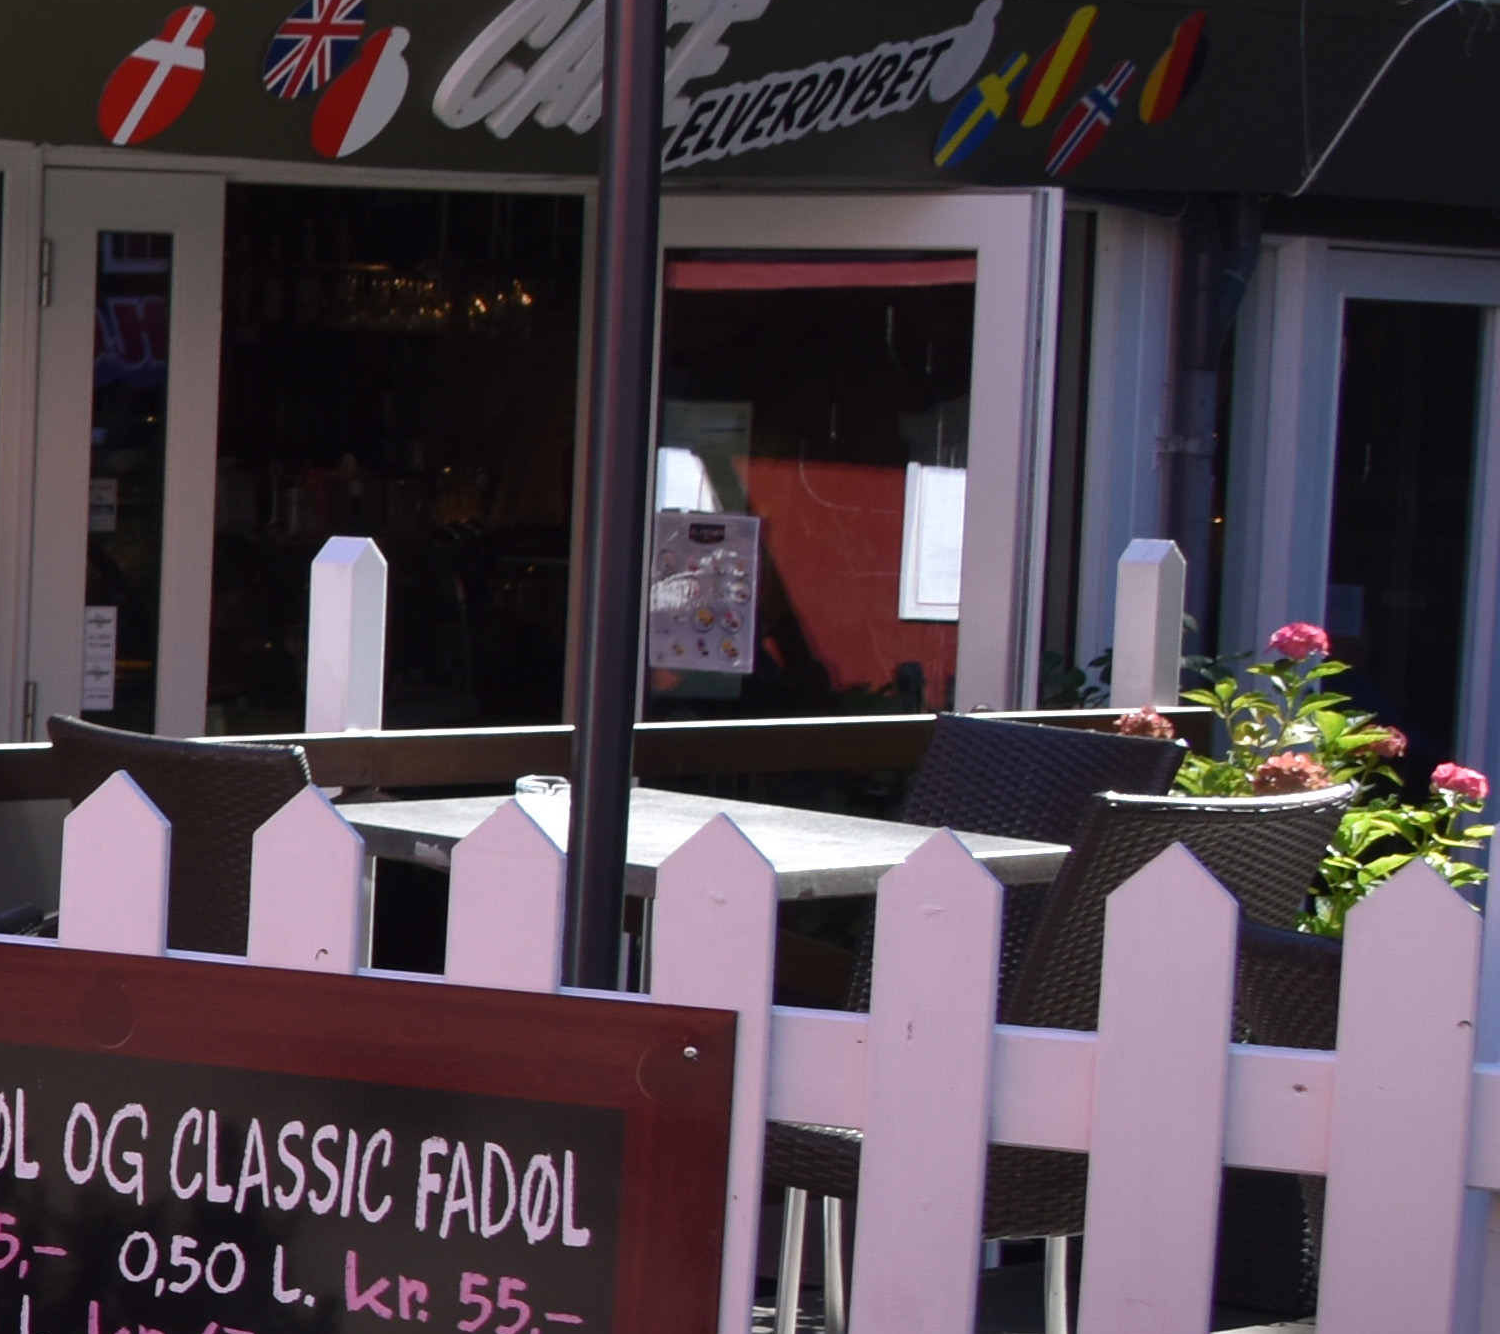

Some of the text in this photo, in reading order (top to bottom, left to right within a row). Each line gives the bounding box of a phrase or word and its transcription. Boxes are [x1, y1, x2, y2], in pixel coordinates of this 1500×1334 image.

[665, 38, 956, 163] ELVERDYBET
[63, 1101, 149, 1206] OG
[170, 1106, 394, 1224] CLASSIC
[415, 1136, 591, 1247] FADØL
[118, 1230, 246, 1298] 0,50
[344, 1249, 430, 1323] kr.
